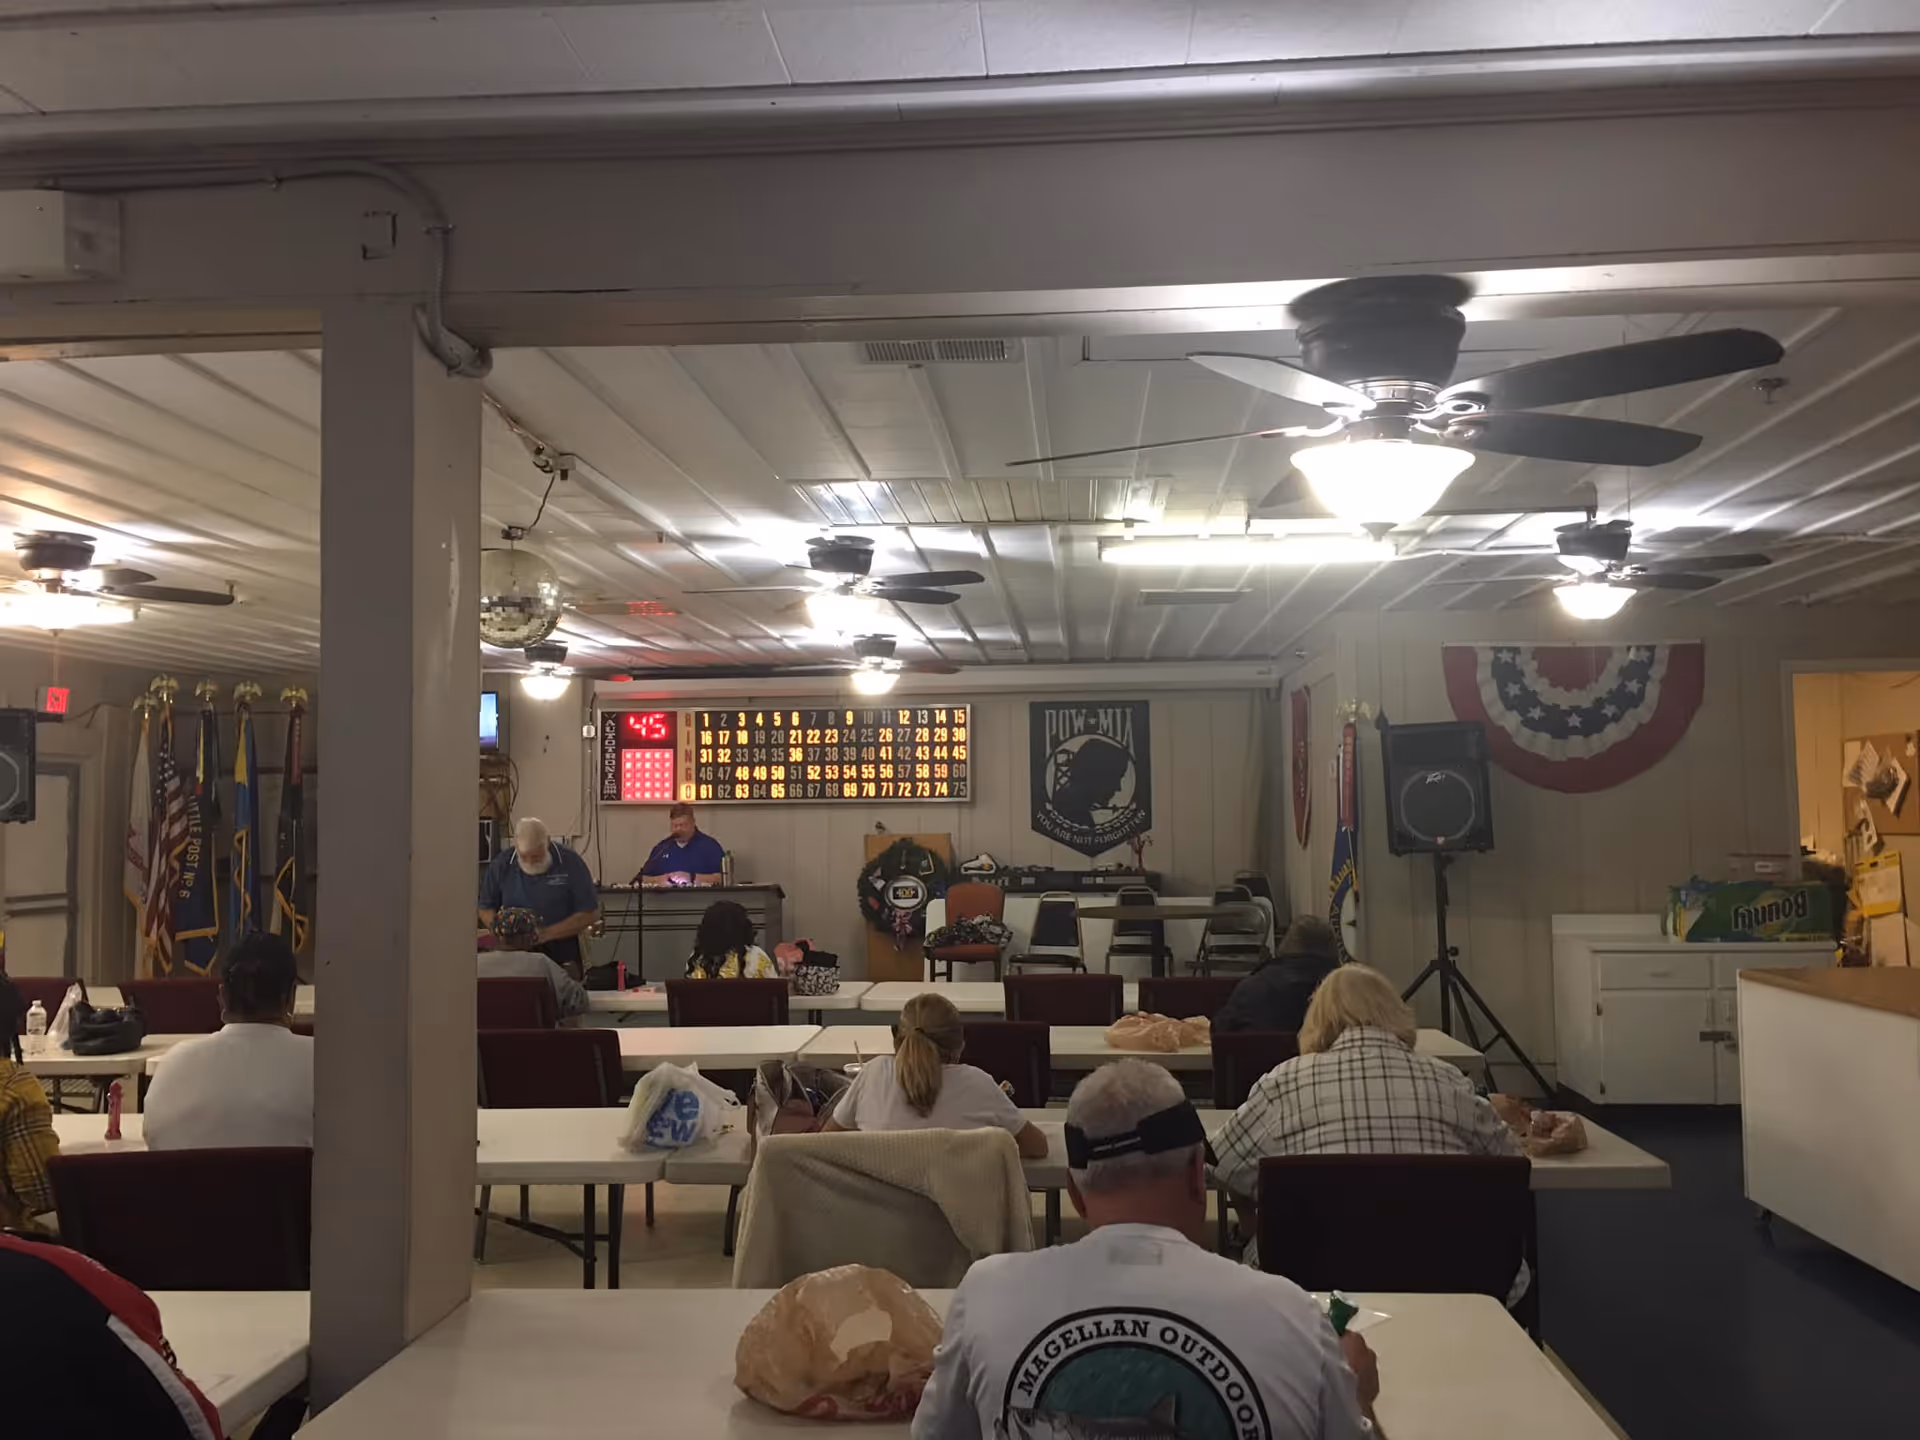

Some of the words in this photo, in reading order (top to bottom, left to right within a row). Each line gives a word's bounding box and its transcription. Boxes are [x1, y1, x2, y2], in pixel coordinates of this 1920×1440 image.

[629, 713, 666, 739] 45
[703, 712, 709, 727] 1
[720, 713, 727, 727] 2
[738, 712, 746, 727] 3
[756, 712, 763, 727] 4
[774, 712, 781, 726] 5
[792, 711, 800, 725] 6
[810, 712, 816, 726] 7
[828, 711, 835, 725] 8
[846, 711, 853, 725] 9
[864, 711, 873, 724] 10
[882, 711, 891, 724] 11
[898, 710, 910, 724] 12
[916, 710, 928, 724] 13
[934, 710, 946, 724] 14
[953, 710, 965, 724] 15
[700, 731, 712, 745] 16
[718, 731, 730, 744] 17
[737, 730, 748, 744] 18
[755, 731, 765, 744] 19
[771, 730, 785, 744] 20
[789, 730, 802, 744] 21
[807, 729, 820, 743] 22
[825, 729, 838, 743] 23
[843, 729, 856, 743] 24
[861, 729, 874, 742] 25
[879, 728, 892, 742] 26
[898, 728, 910, 742] 27
[916, 728, 929, 742] 28
[934, 728, 947, 742] 29
[952, 728, 966, 742] 30
[1045, 709, 1087, 756] POW
[1097, 707, 1136, 760] MIA
[700, 749, 712, 763] 31
[717, 749, 731, 763] 32
[736, 749, 749, 762] 33
[753, 749, 766, 762] 34
[772, 748, 784, 761] 35
[789, 748, 803, 762] 36
[808, 748, 820, 761] 37
[825, 747, 838, 761] 38
[843, 747, 856, 760] 39
[861, 747, 875, 760] 40
[880, 747, 892, 760] 41
[898, 746, 911, 760] 42
[916, 746, 929, 760] 43
[934, 746, 948, 760] 44
[952, 746, 966, 760] 45
[700, 767, 713, 781] 46
[718, 767, 731, 780] 47
[735, 767, 749, 780] 48
[753, 766, 767, 780] 49
[771, 766, 785, 780] 50
[790, 766, 801, 779] 51
[807, 766, 821, 780] 52
[825, 765, 839, 779] 53
[843, 765, 857, 779] 54
[861, 765, 875, 779] 55
[880, 764, 893, 778] 56
[898, 764, 911, 778] 57
[916, 764, 930, 778] 58
[934, 764, 948, 778] 59
[953, 764, 966, 778] 60
[700, 784, 712, 798] 61
[718, 785, 730, 798] 62
[735, 784, 749, 798] 63
[753, 784, 767, 798] 64
[771, 784, 785, 798] 65
[789, 784, 802, 798] 66
[807, 784, 820, 797] 67
[826, 784, 839, 797] 68
[844, 783, 857, 797] 69
[862, 782, 875, 797] 70
[881, 782, 893, 797] 71
[898, 782, 911, 797] 72
[916, 782, 930, 796] 73
[934, 782, 948, 796] 74
[953, 782, 966, 796] 75
[1036, 810, 1053, 830] YOU
[1054, 828, 1071, 841] ARE
[1073, 834, 1091, 845] NOT
[1094, 810, 1146, 844] FORGOTTEN
[185, 839, 201, 868] POST
[1732, 888, 1808, 931] Bounty
[1017, 1320, 1151, 1397] MAGELLAN
